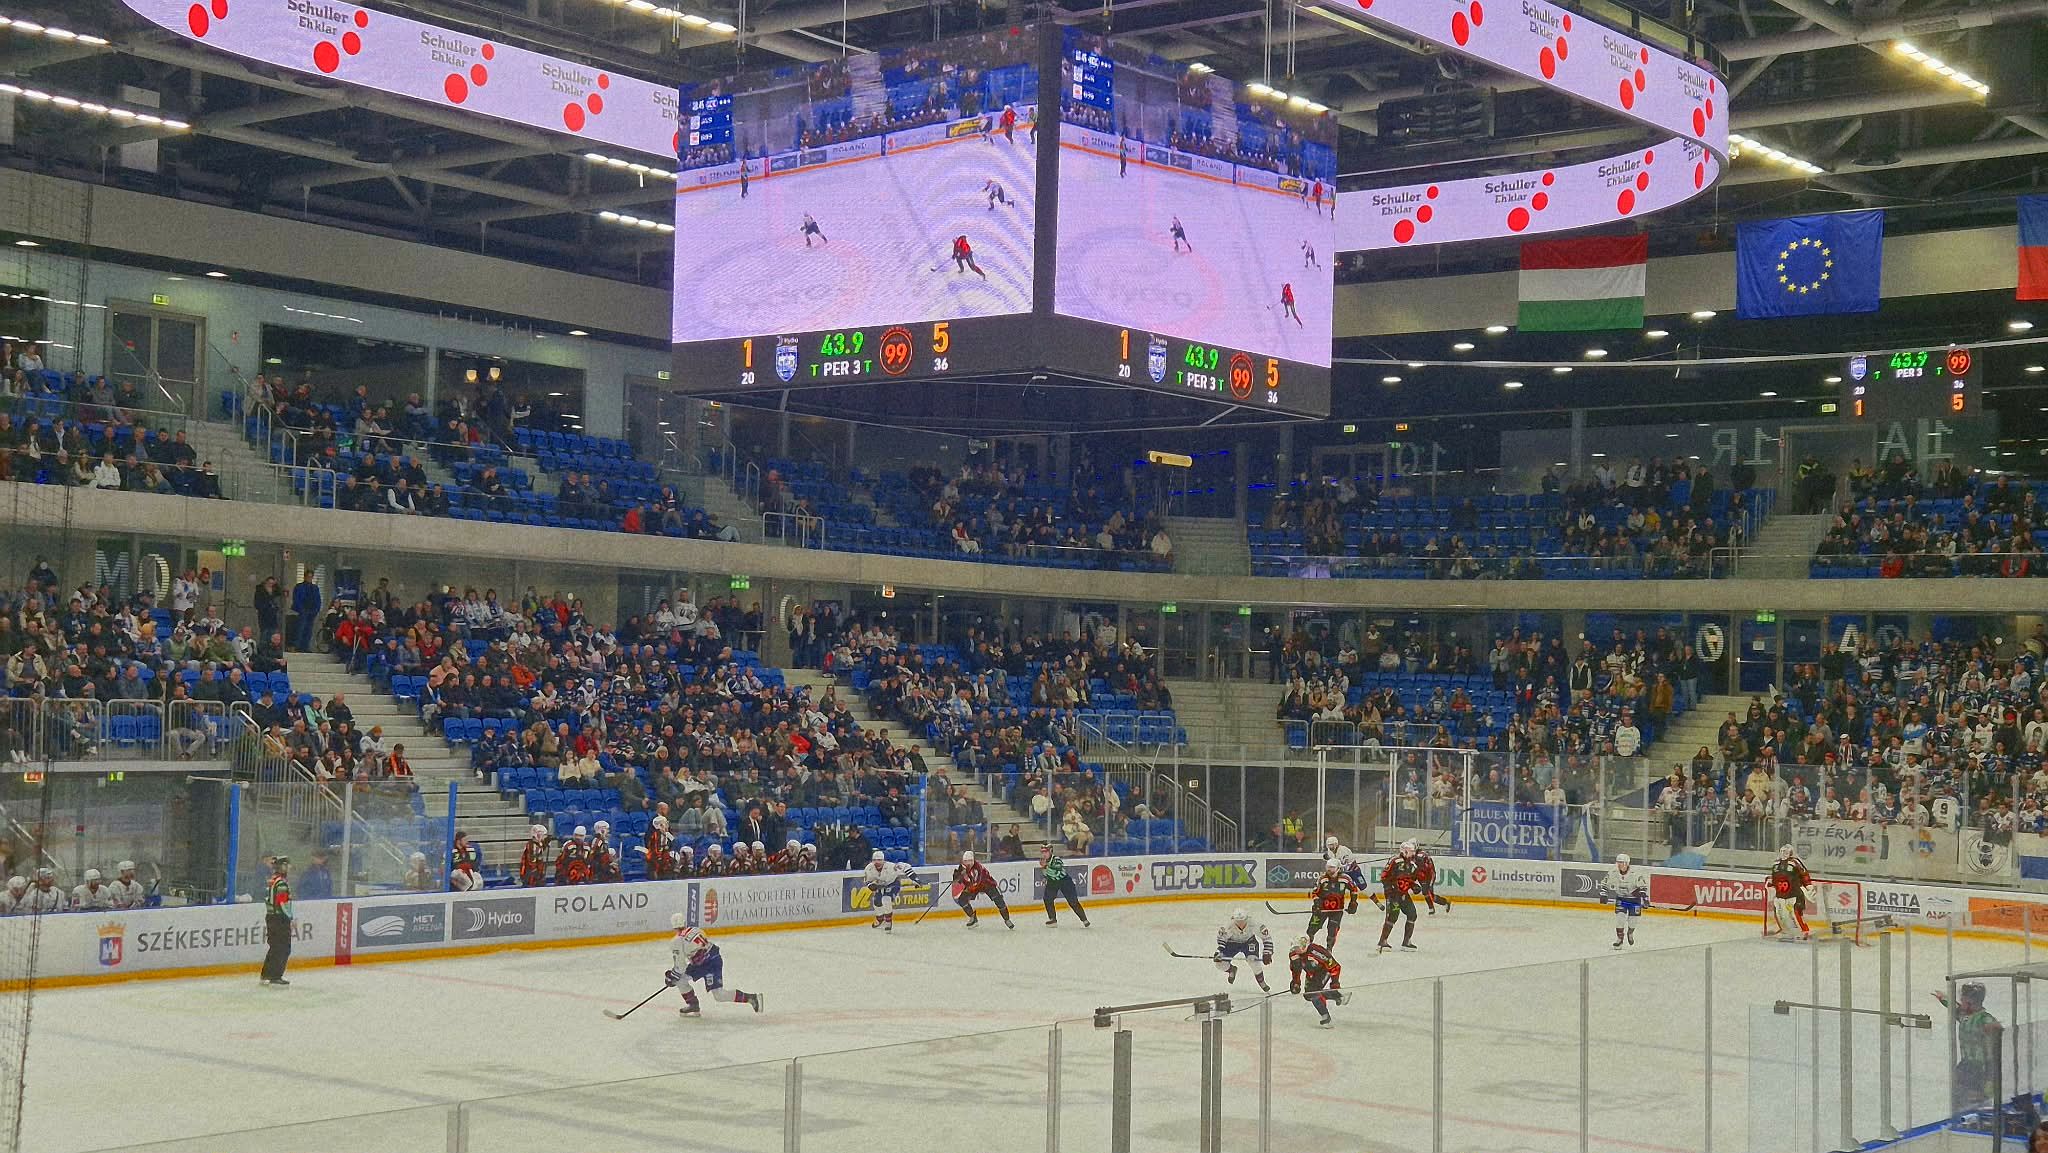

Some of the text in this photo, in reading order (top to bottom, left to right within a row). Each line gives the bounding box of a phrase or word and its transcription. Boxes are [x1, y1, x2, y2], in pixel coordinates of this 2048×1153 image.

[288, 0, 349, 24] Schuller
[1523, 1, 1560, 29] Schuller
[421, 31, 477, 57] Schuller
[1603, 36, 1638, 61] Schuller
[542, 63, 593, 87] Schuller
[1598, 160, 1641, 178] Schuller
[1485, 179, 1537, 194] Schuller
[1372, 192, 1422, 206] Schuller
[820, 331, 865, 358] 43.9
[933, 322, 949, 353] 5
[1120, 329, 1129, 360] 1
[743, 339, 753, 368] 1
[884, 343, 908, 365] 99
[1185, 344, 1219, 370] 43.9
[1950, 356, 1966, 369] 99
[823, 361, 849, 377] PER
[852, 360, 861, 375] 3
[934, 358, 949, 371] 36
[1118, 364, 1131, 378] 20
[1267, 358, 1279, 387] 5
[1896, 368, 1915, 378] PER
[1916, 367, 1923, 377] 3
[741, 372, 755, 384] 20
[1187, 372, 1207, 389] PER
[1209, 375, 1216, 391] 3
[1233, 368, 1250, 389] 99
[1267, 391, 1278, 404] 36
[1953, 393, 1964, 411] 5
[1854, 399, 1864, 416] 1
[1473, 808, 1540, 822] BLUE-WHITE
[1940, 803, 1949, 816] 9
[1492, 868, 1555, 884] Lindström
[554, 892, 649, 914] ROLAND
[1867, 890, 1920, 907] BARTA
[413, 914, 435, 924] MET
[487, 911, 523, 928] Hydro
